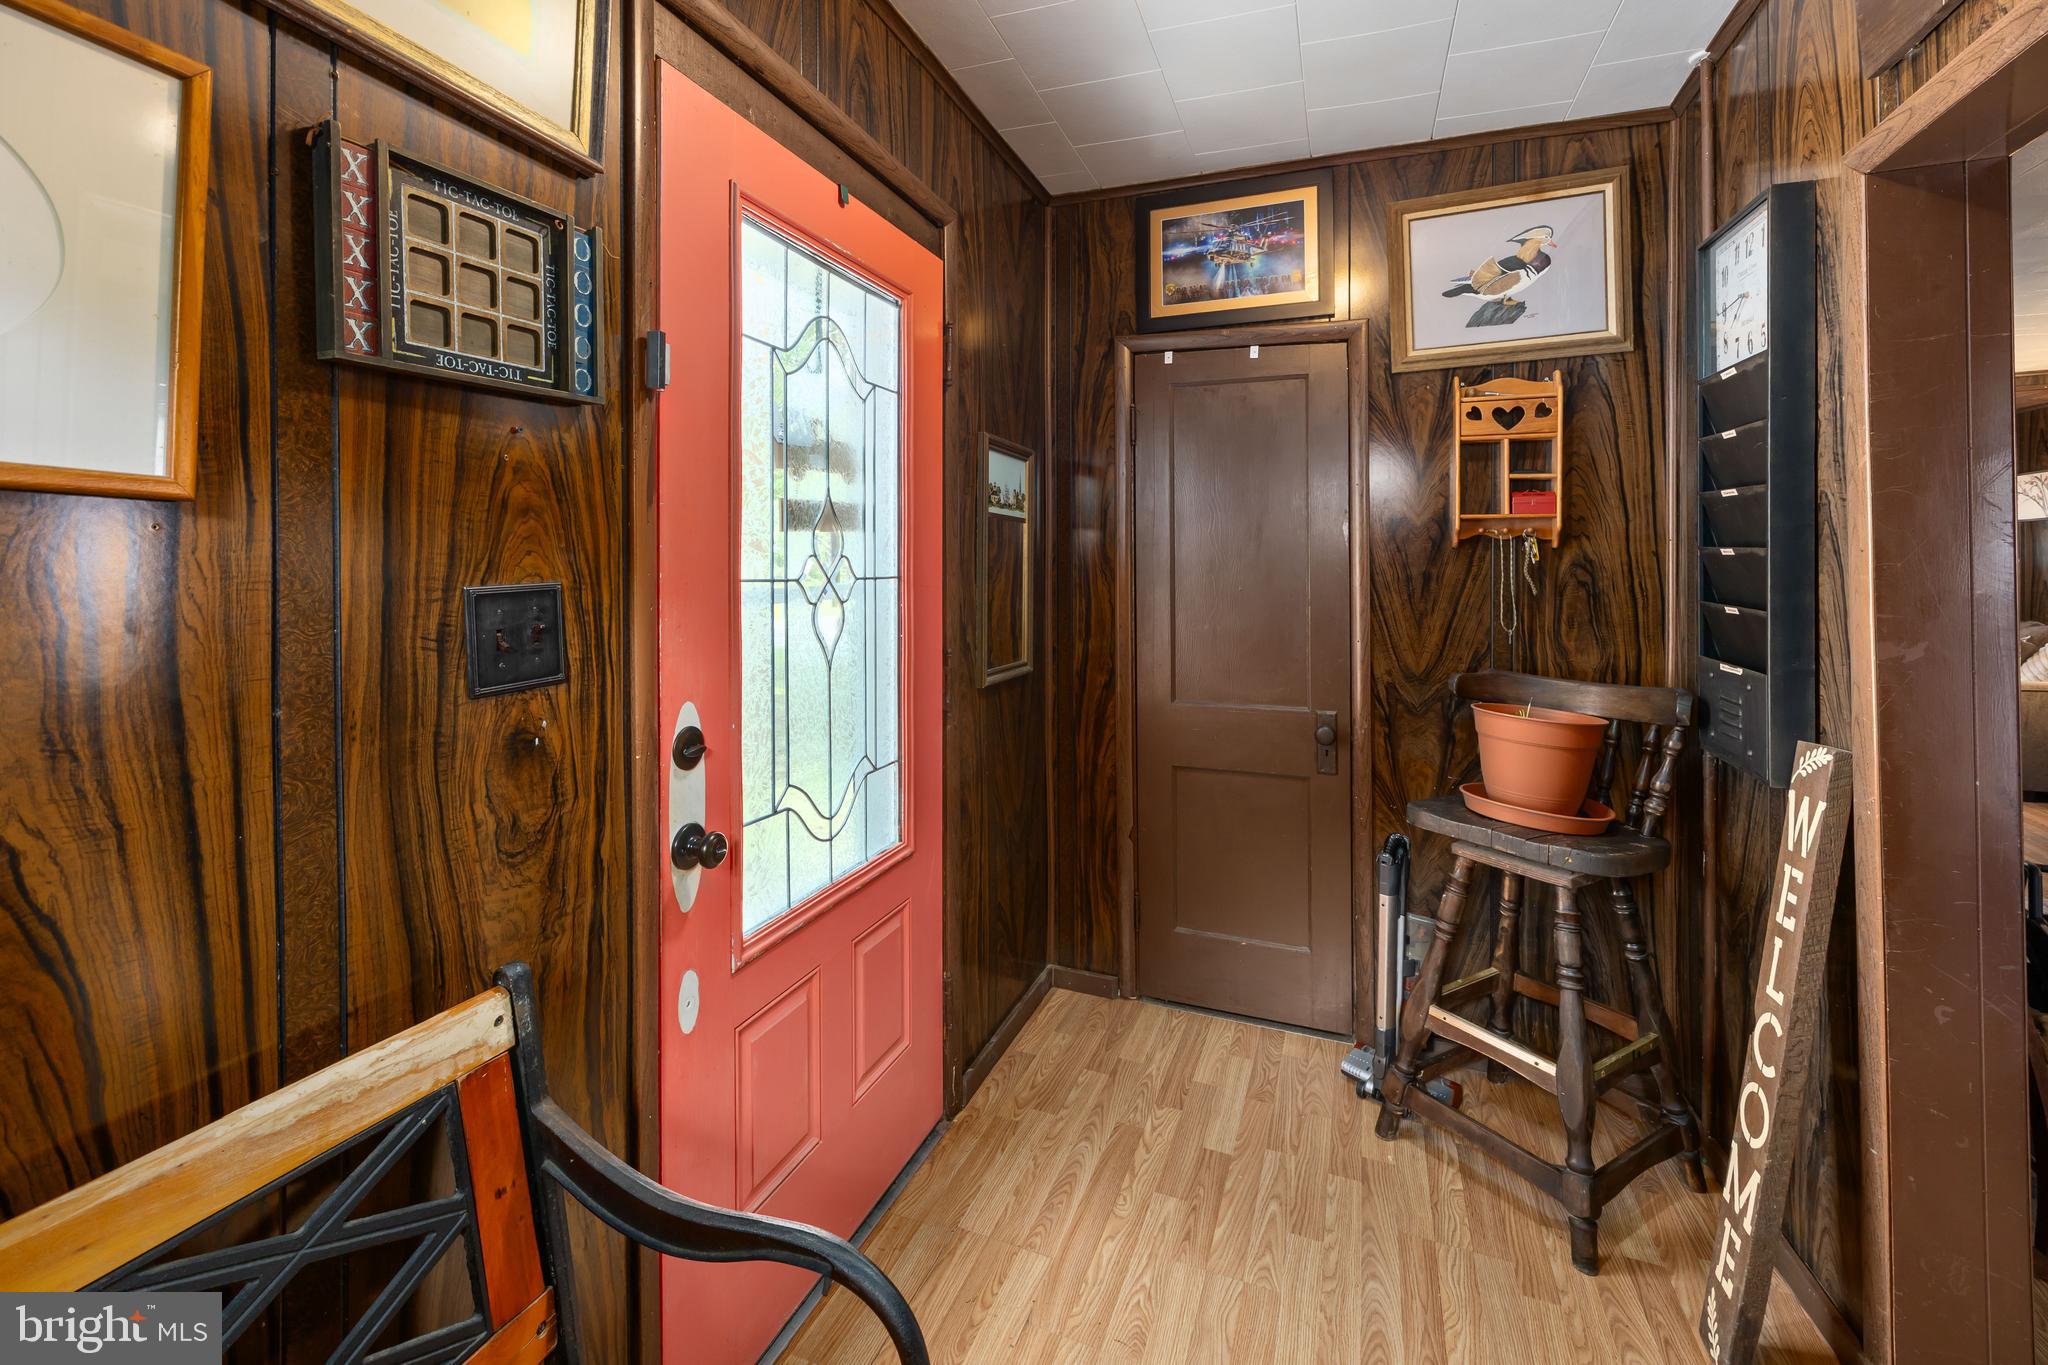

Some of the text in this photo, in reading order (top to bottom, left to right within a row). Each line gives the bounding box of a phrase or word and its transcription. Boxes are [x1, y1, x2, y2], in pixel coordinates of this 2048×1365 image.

[341, 148, 369, 186] X
[342, 190, 372, 228] X
[431, 178, 520, 222] TIC-TAC-TOE
[343, 233, 371, 270] X
[1744, 231, 1755, 260] 12
[344, 276, 374, 312] X
[1720, 265, 1729, 289] 10
[545, 264, 558, 350] TIC-TAC-TOE
[345, 318, 374, 353] X
[435, 353, 522, 382] TIC-TAC-TOE
[1714, 789, 1827, 1299] WELCOME
